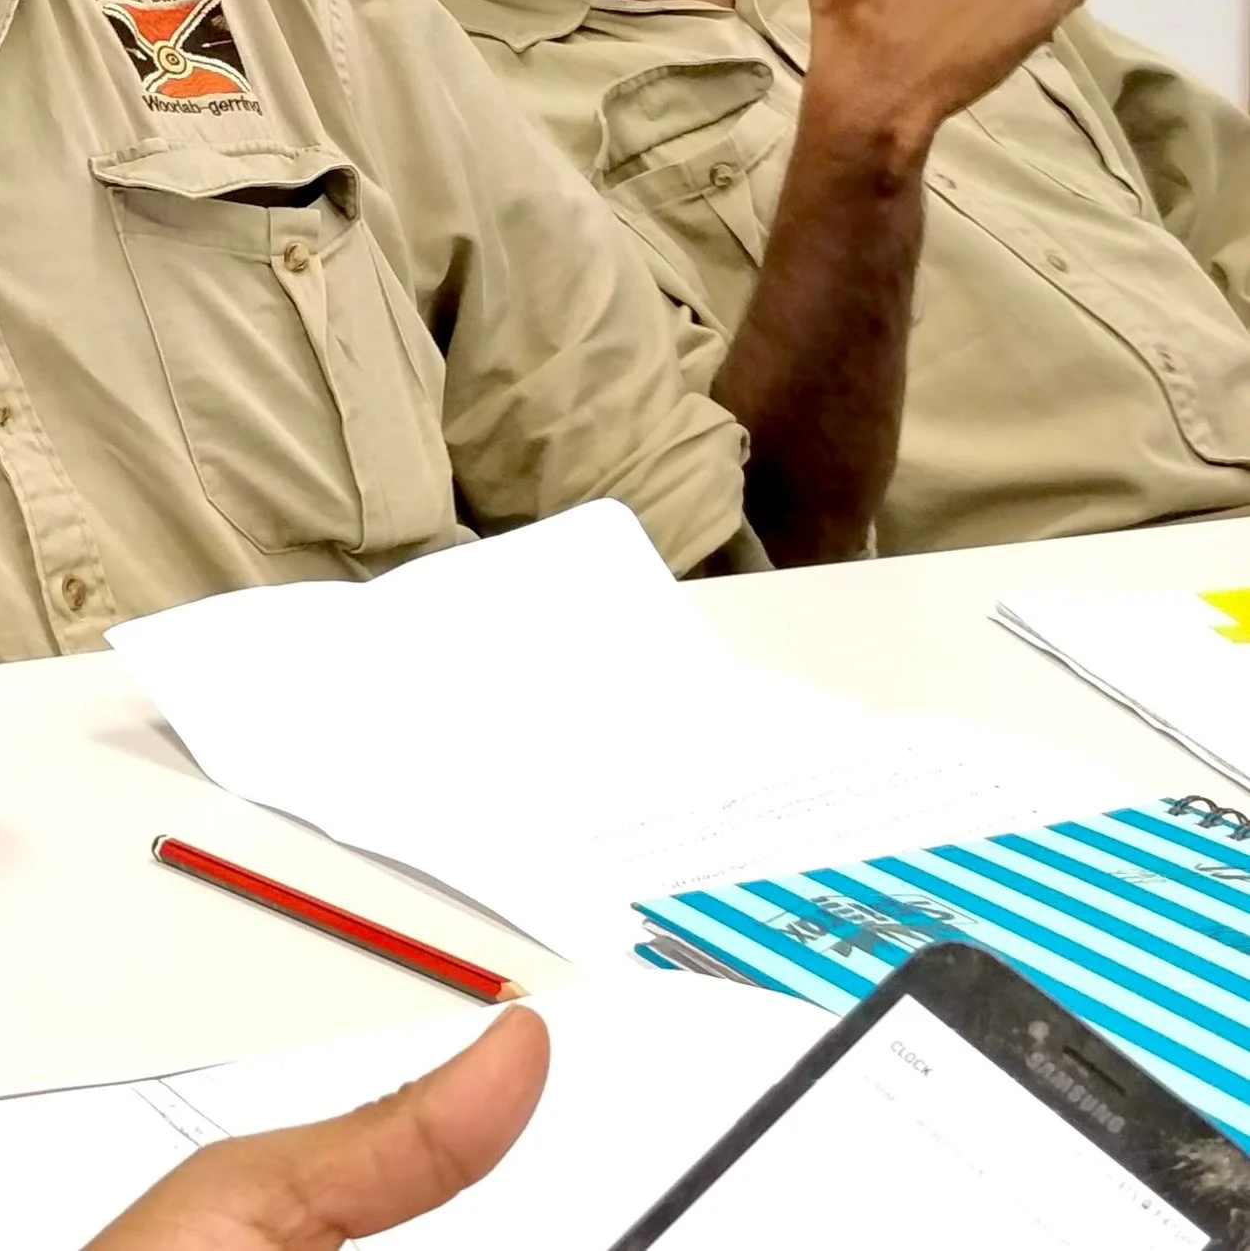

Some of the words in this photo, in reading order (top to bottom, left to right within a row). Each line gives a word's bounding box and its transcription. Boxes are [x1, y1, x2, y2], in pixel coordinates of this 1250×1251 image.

[142, 94, 264, 117] Woorlab-gerring
[889, 1039, 934, 1078] CLOCK
[1025, 1050, 1127, 1134] SAMSUNG
